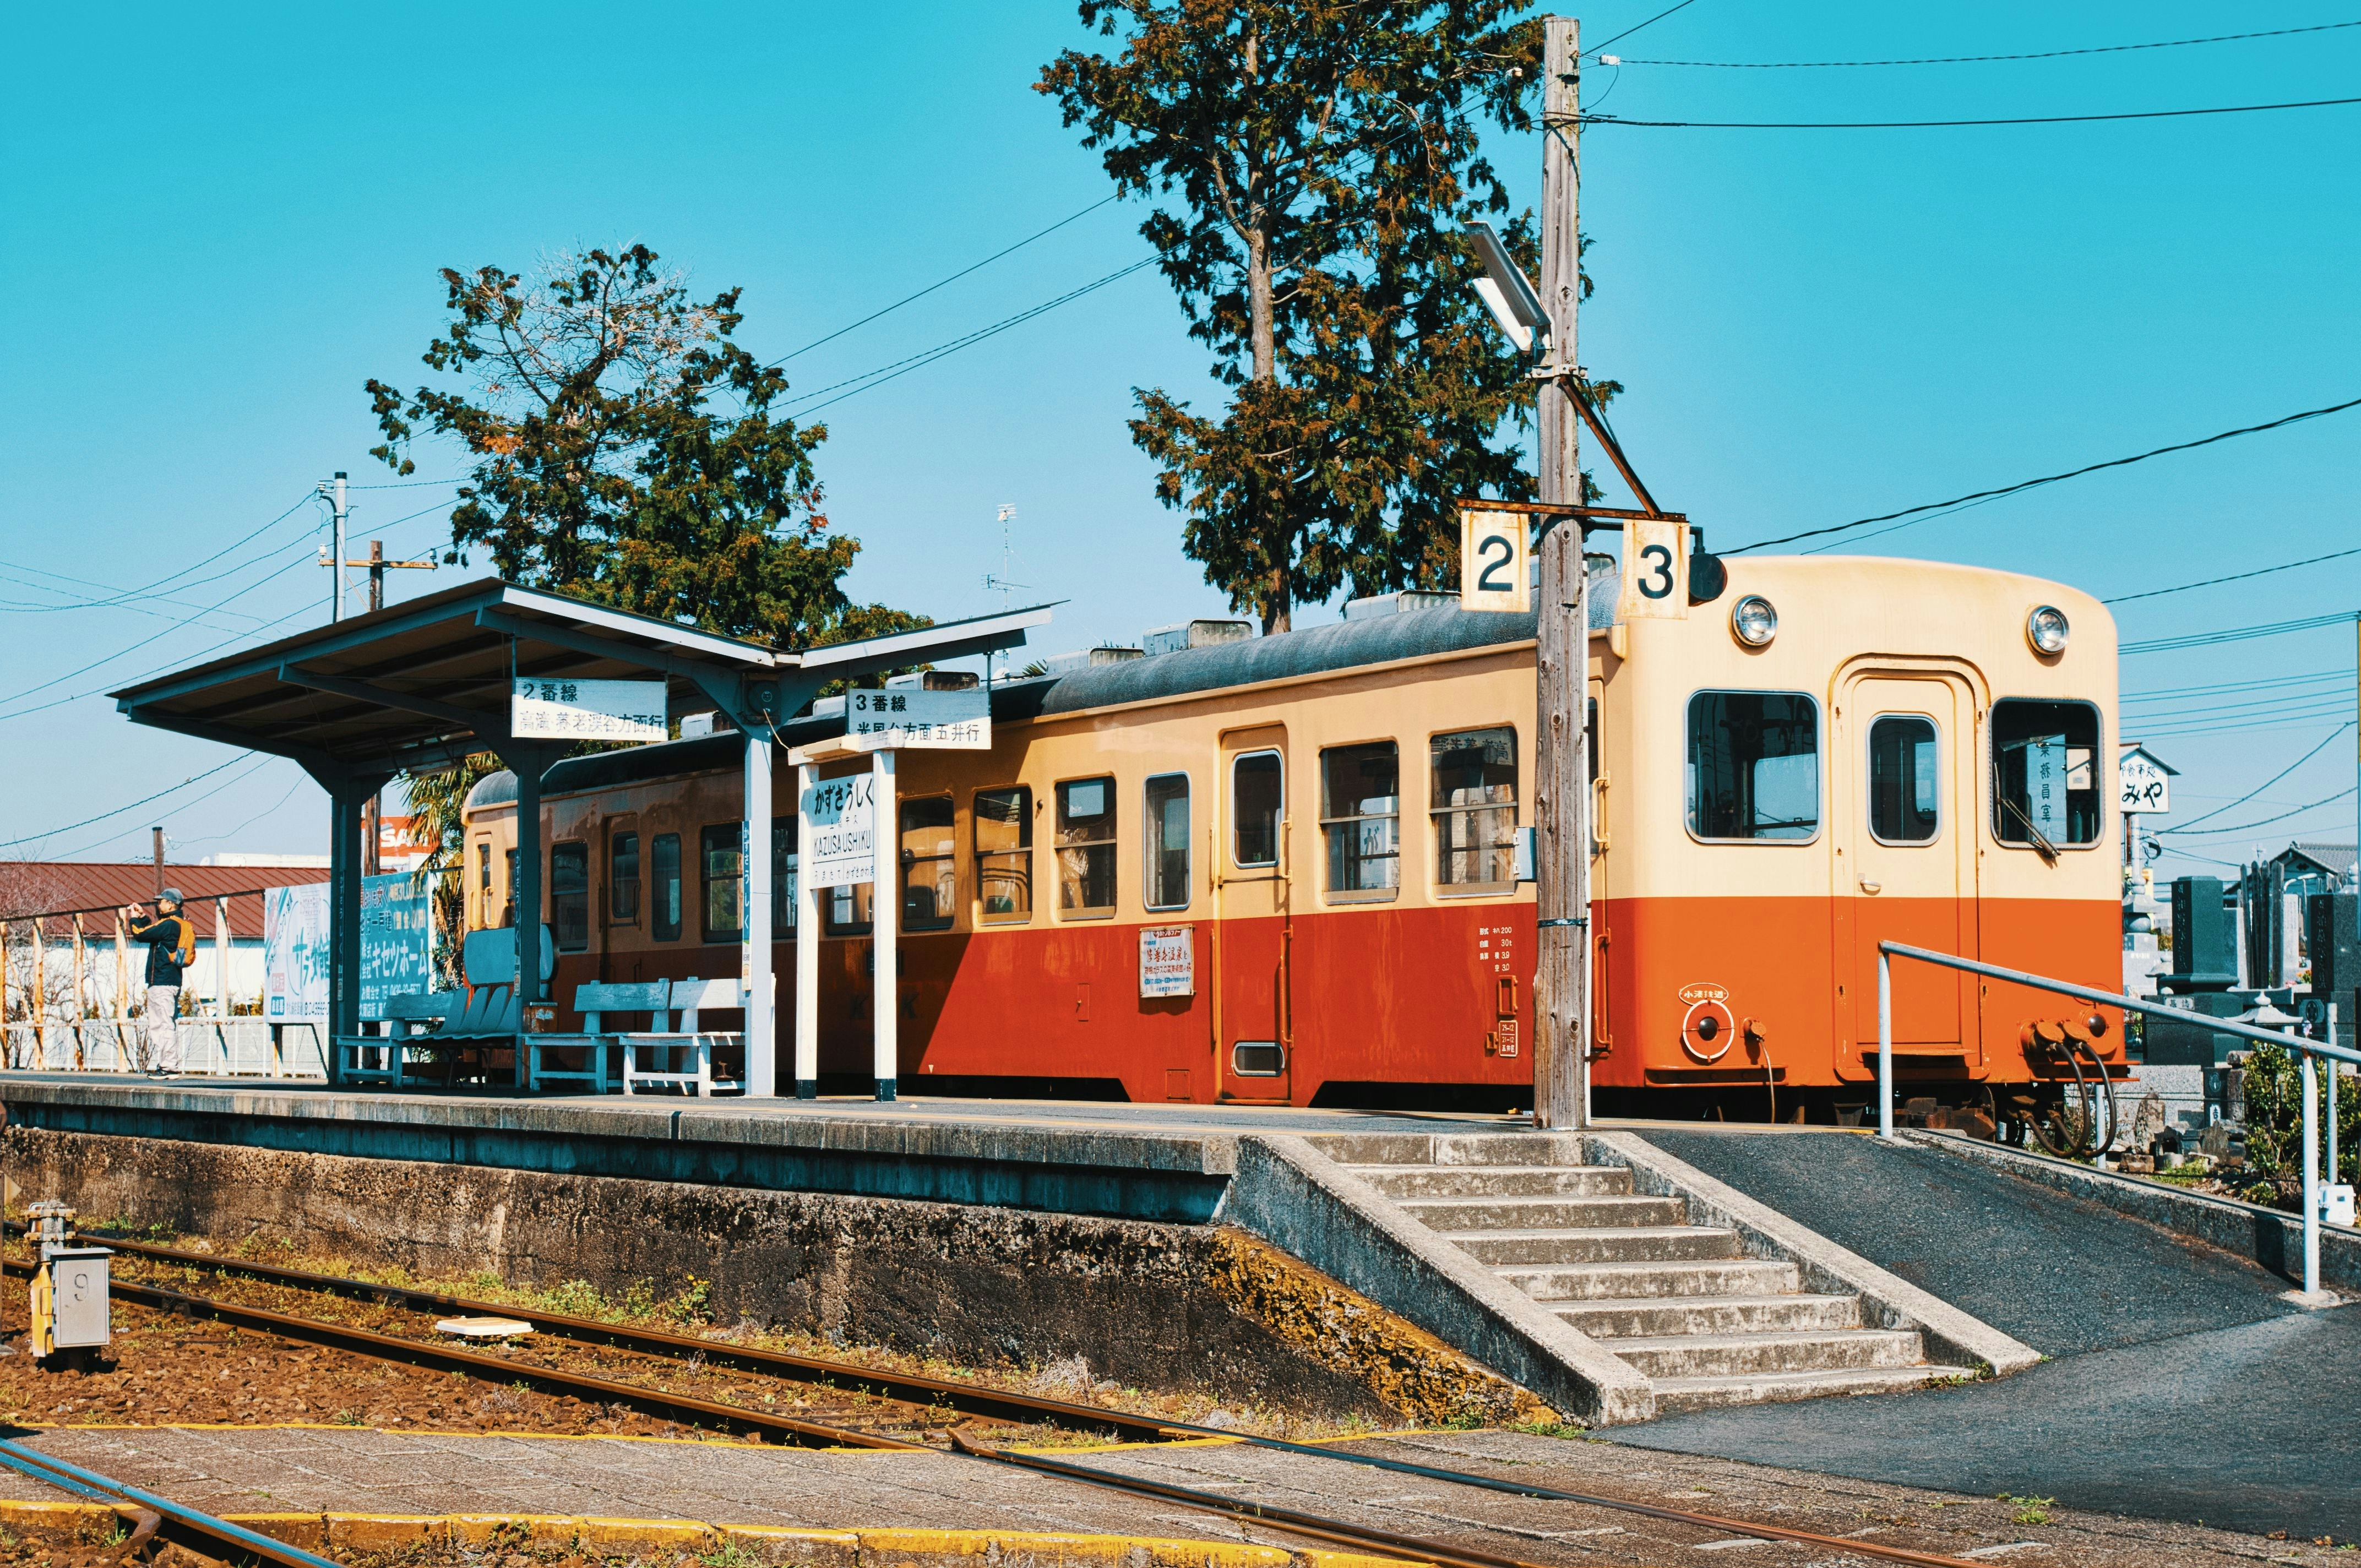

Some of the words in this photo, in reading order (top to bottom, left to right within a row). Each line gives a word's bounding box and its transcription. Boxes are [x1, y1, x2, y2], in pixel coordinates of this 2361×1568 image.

[1478, 535, 1513, 591] 2
[1638, 544, 1673, 600] 3
[523, 683, 578, 702] 2番線
[856, 694, 907, 712] 3番線
[815, 778, 873, 815] かずさうしく
[372, 938, 427, 978] キセツホーム
[1501, 939, 1512, 947] 30t
[74, 1273, 89, 1301] 9
